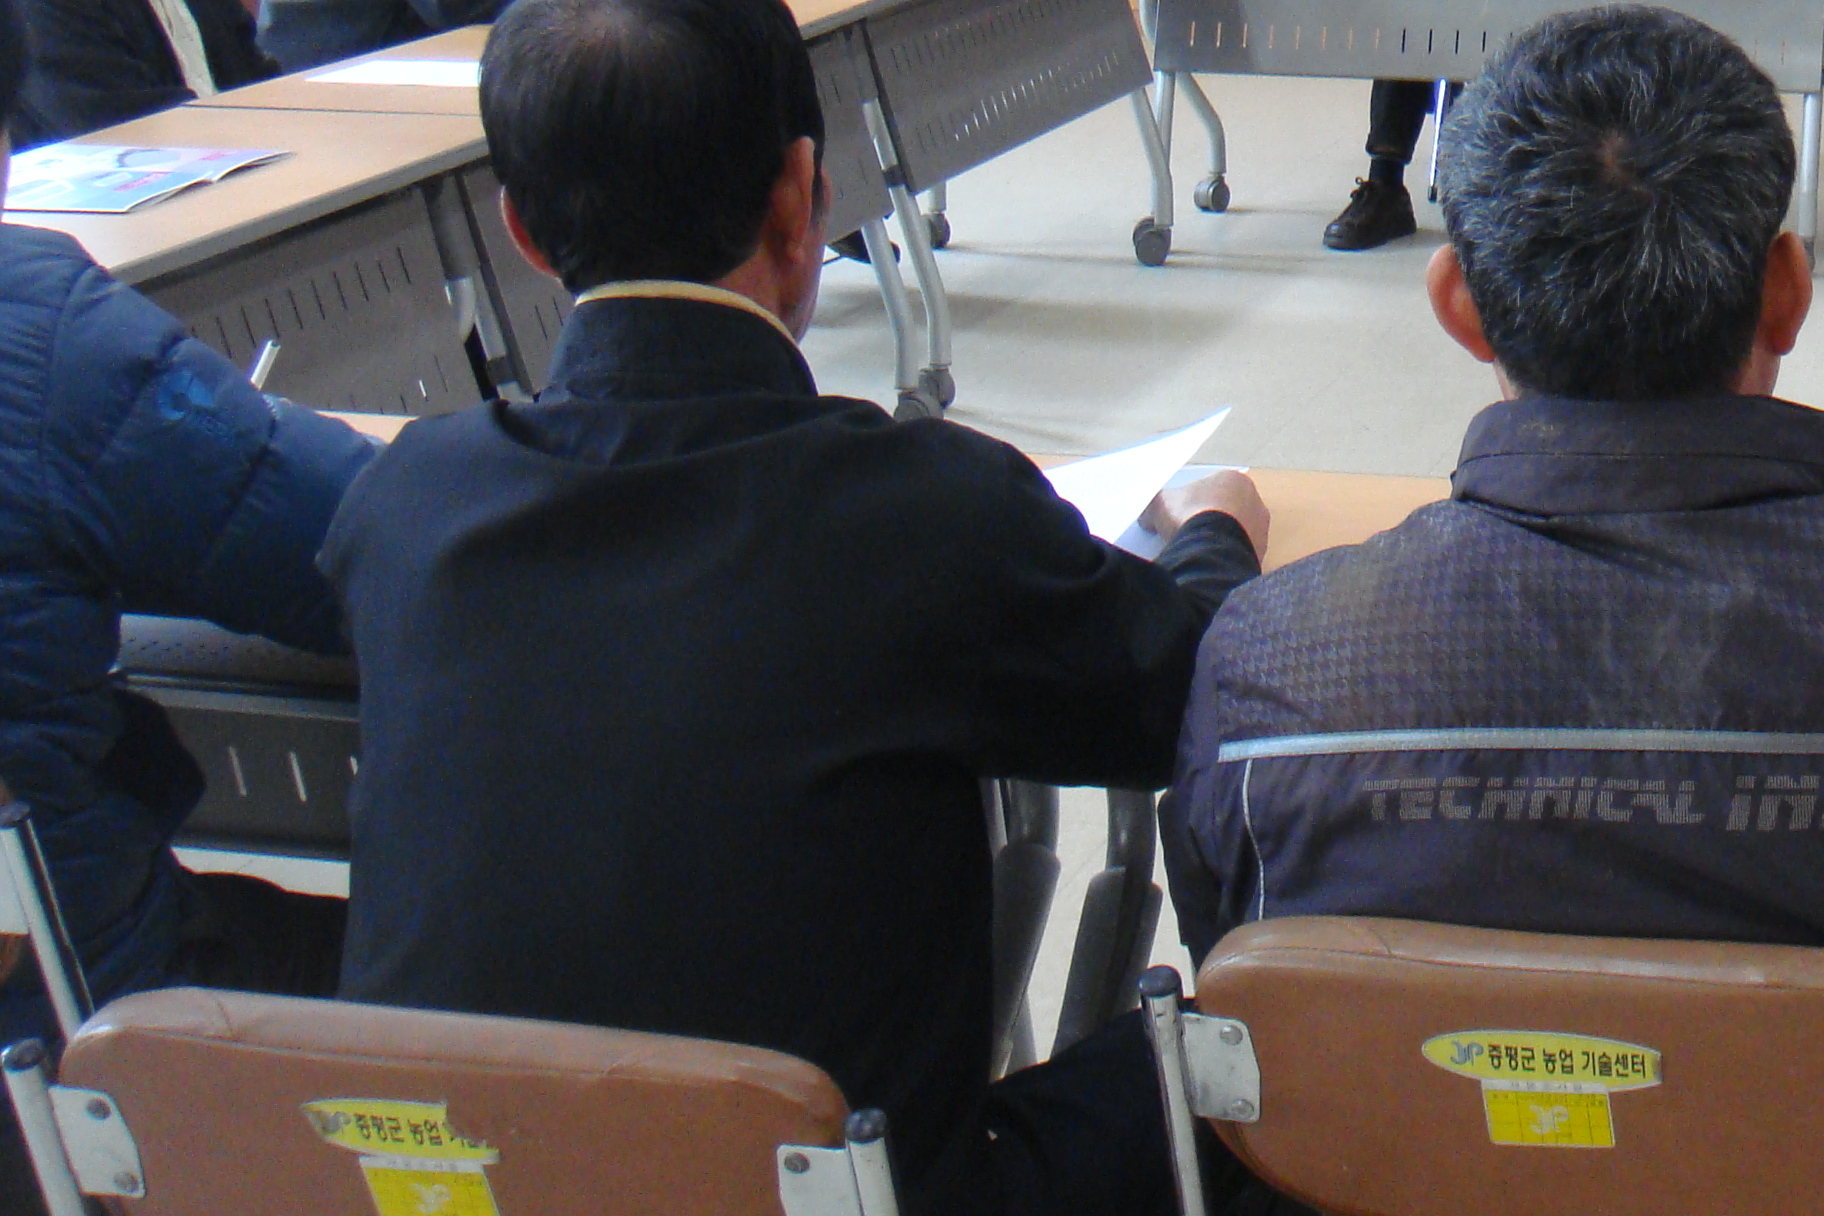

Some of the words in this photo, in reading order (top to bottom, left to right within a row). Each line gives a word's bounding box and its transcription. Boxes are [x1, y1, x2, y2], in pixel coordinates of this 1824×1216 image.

[1487, 1043, 1536, 1072] 증평군
[1542, 1047, 1574, 1075] 농업
[1581, 1051, 1647, 1078] 기술센터
